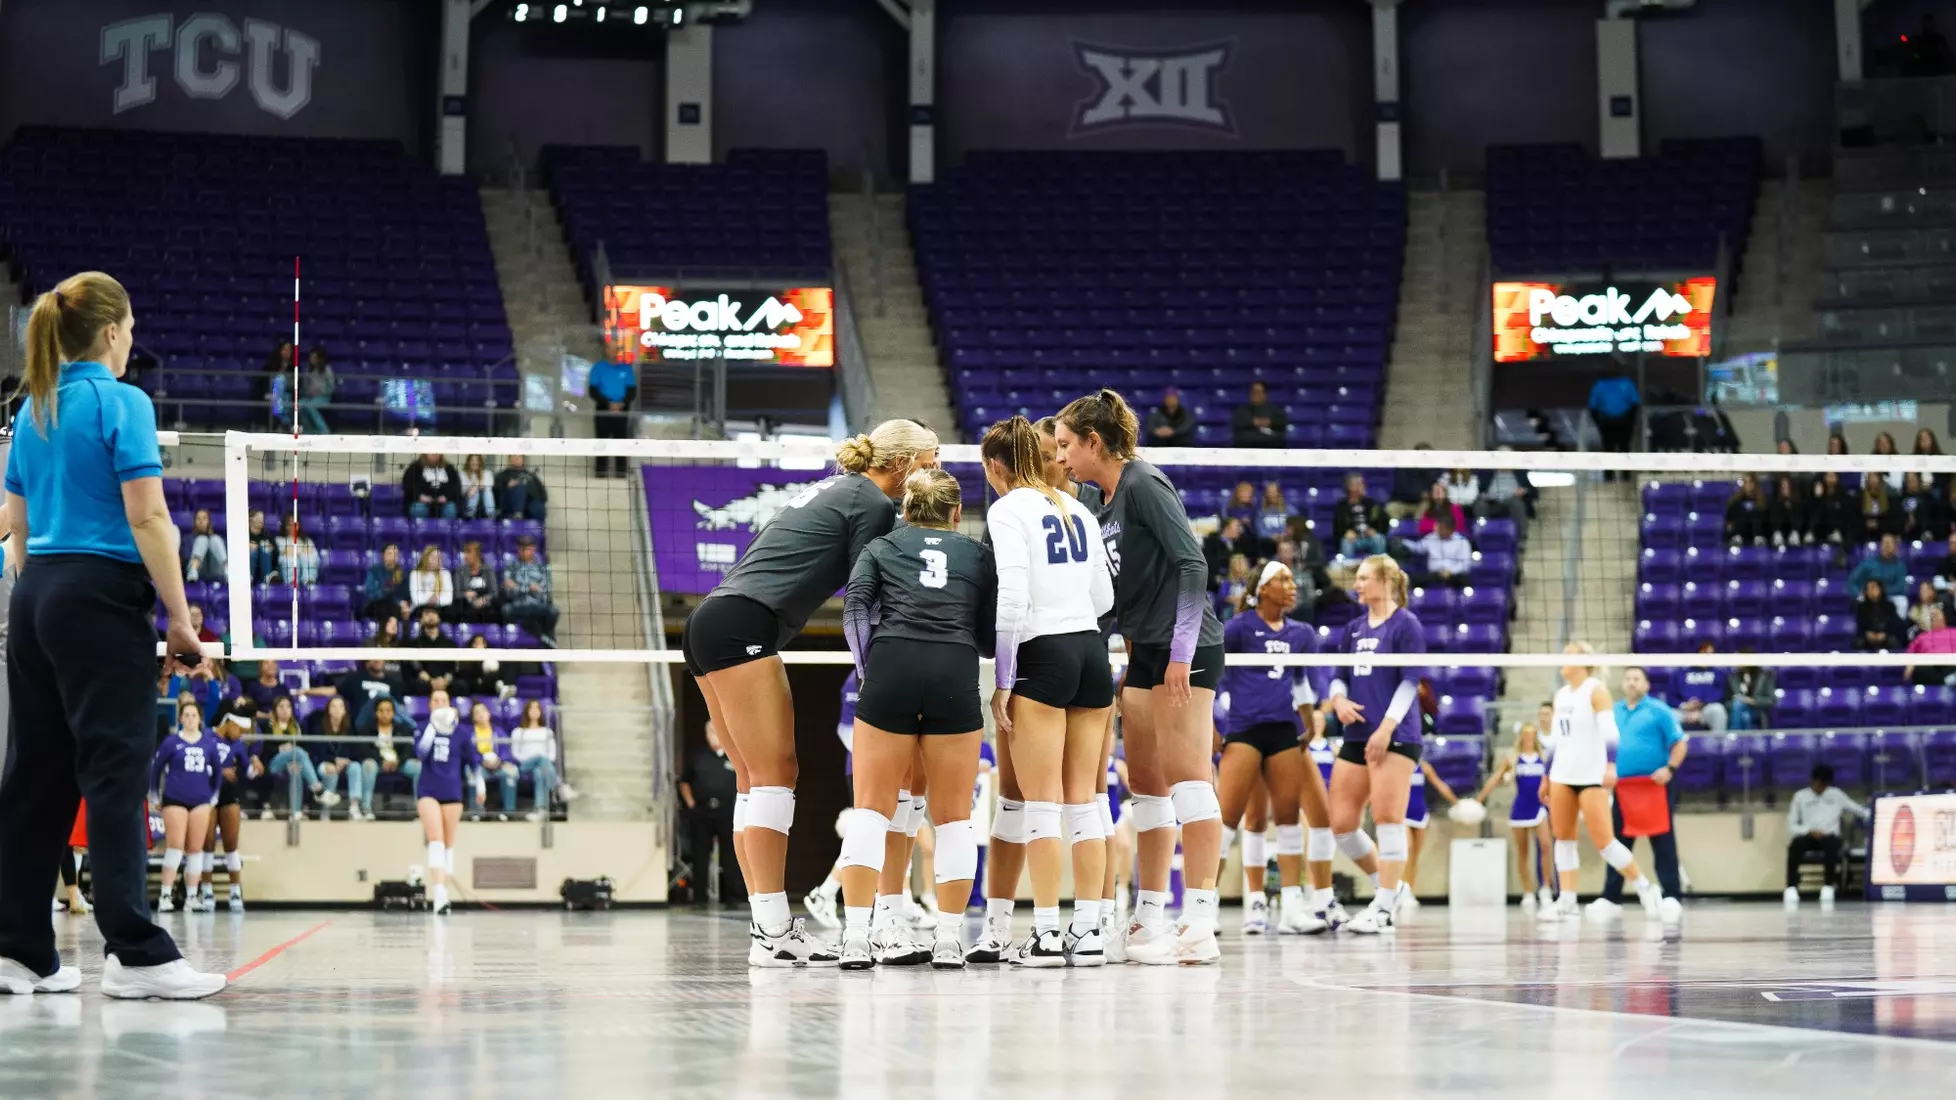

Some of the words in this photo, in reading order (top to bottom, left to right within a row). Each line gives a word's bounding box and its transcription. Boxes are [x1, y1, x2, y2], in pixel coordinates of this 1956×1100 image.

[99, 12, 322, 120] TCU
[1081, 49, 1227, 126] XII
[639, 292, 743, 332] Peak
[1528, 286, 1633, 327] Peak
[1041, 513, 1089, 564] 20
[918, 548, 949, 590] 3
